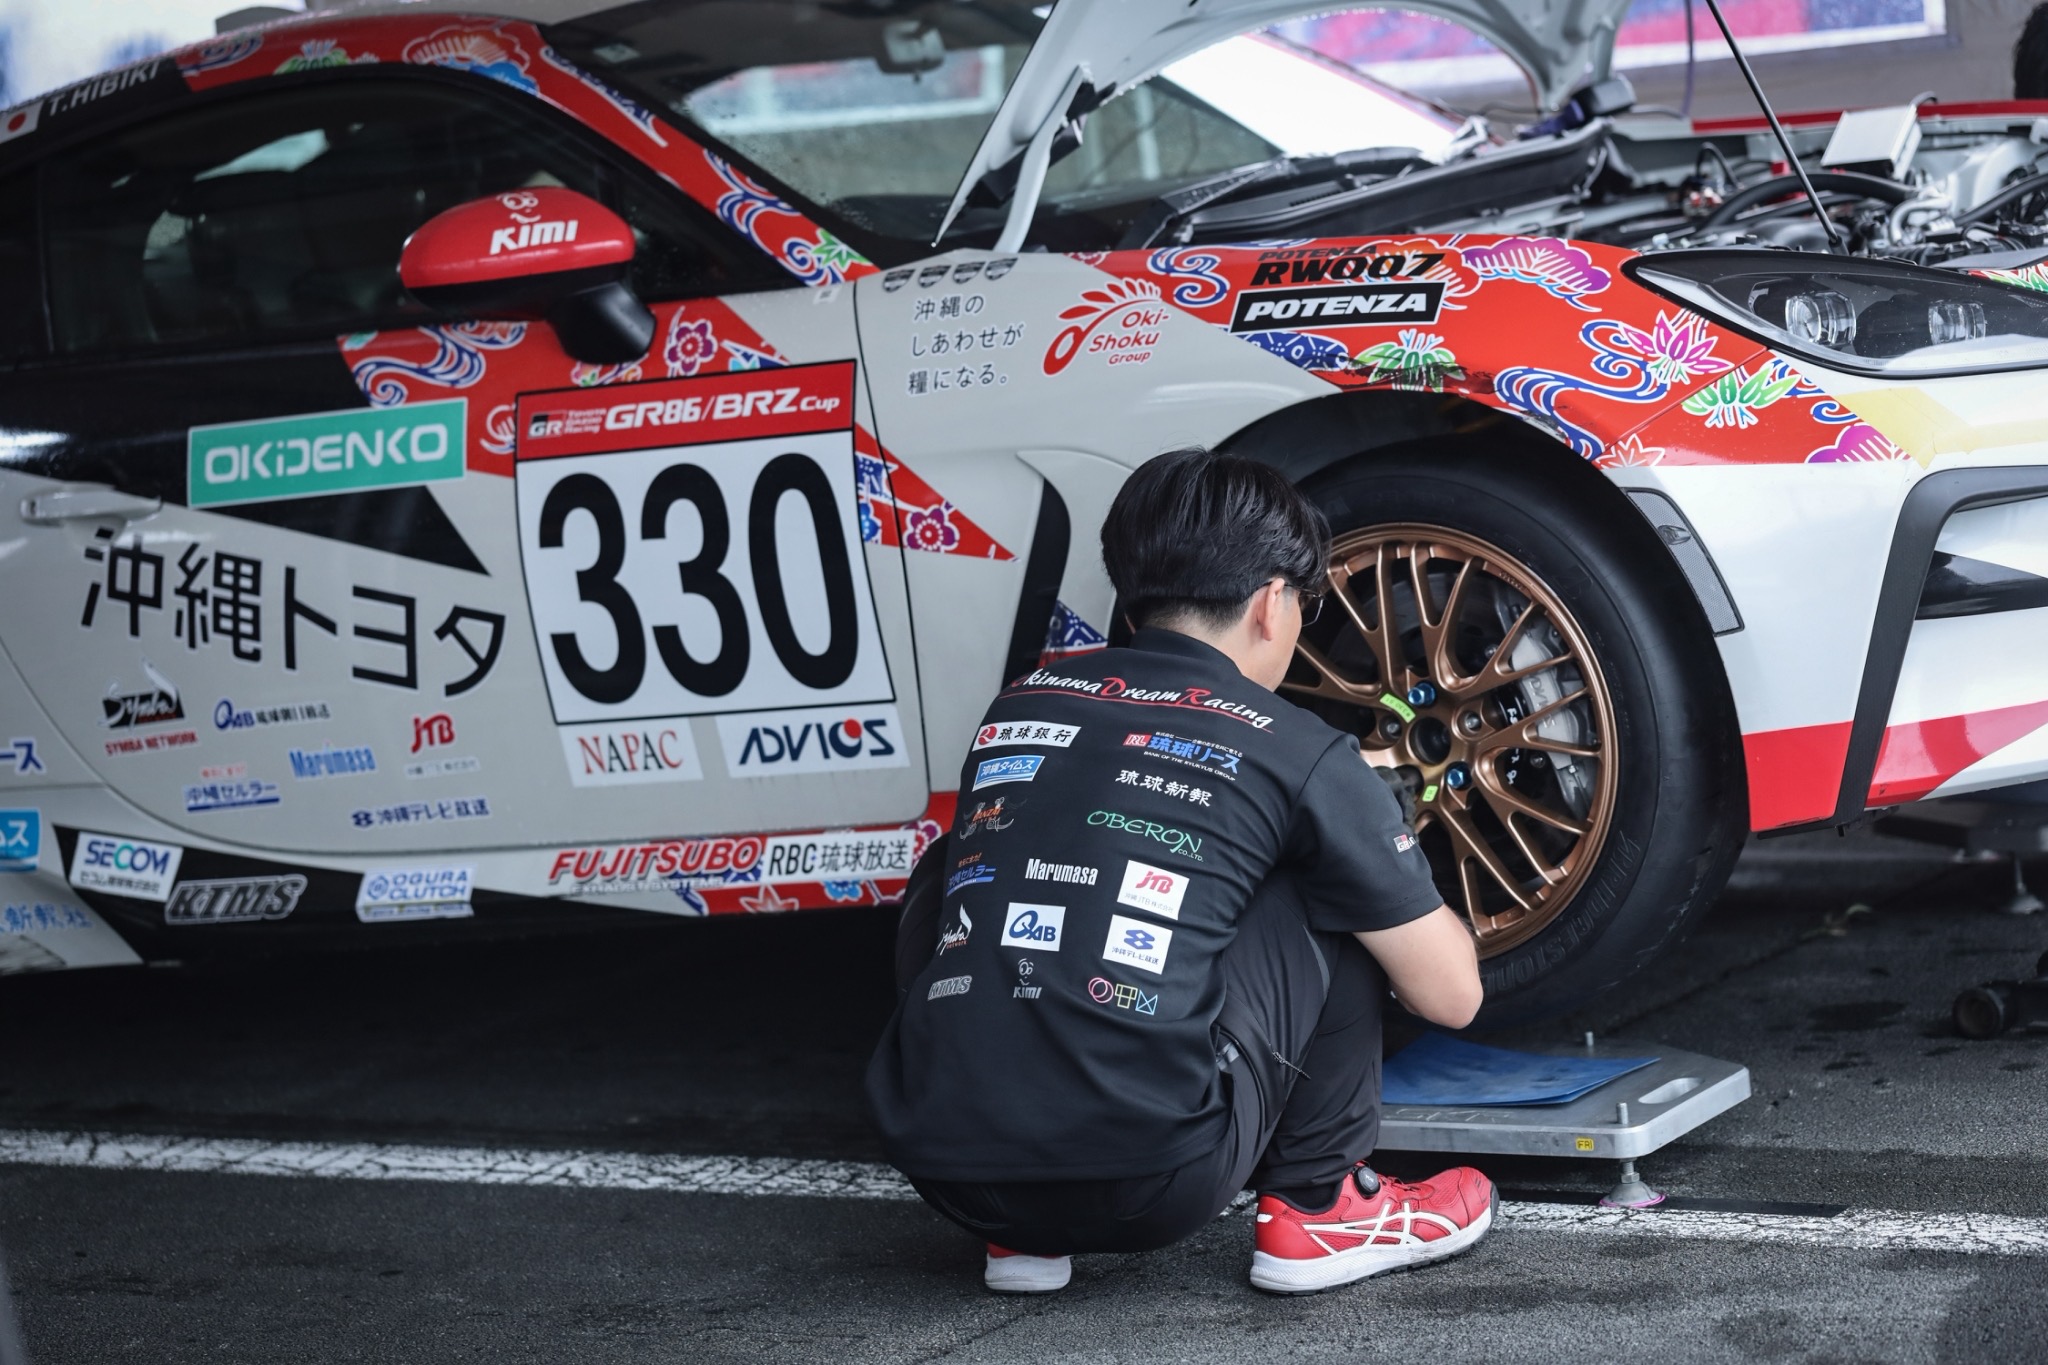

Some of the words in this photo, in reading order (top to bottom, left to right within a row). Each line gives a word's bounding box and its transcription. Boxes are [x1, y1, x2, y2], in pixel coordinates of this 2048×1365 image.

[48, 61, 160, 116] T.HIBIKI
[1258, 245, 1377, 261] POTENZA
[913, 295, 984, 321] 沖縄の
[1244, 293, 1427, 322] POTENZA
[912, 324, 1024, 357] しあわせが
[1088, 331, 1160, 352] Shoku
[1108, 351, 1151, 365] Group
[800, 396, 840, 412] Cup
[528, 420, 563, 437] GR
[539, 452, 859, 704] 330
[81, 528, 506, 698] 沖縄トヨタ
[1100, 677, 1178, 703] Dream
[1176, 688, 1275, 729] Racing
[739, 719, 896, 766] ADVICS
[998, 726, 1072, 743] 琉球銀行
[577, 730, 683, 775] NAPAC
[1148, 736, 1240, 774] 琉球リース
[1115, 769, 1212, 807] 琉球新報
[1086, 810, 1202, 853] OBERON
[85, 839, 170, 876] SECOM
[549, 837, 764, 883] FUJITSUBO
[768, 843, 817, 877] RBC
[818, 839, 909, 873] 琉球放送
[1025, 858, 1099, 886] Marumasa
[389, 885, 466, 901] CLUTCH
[392, 870, 467, 886] OGURA
